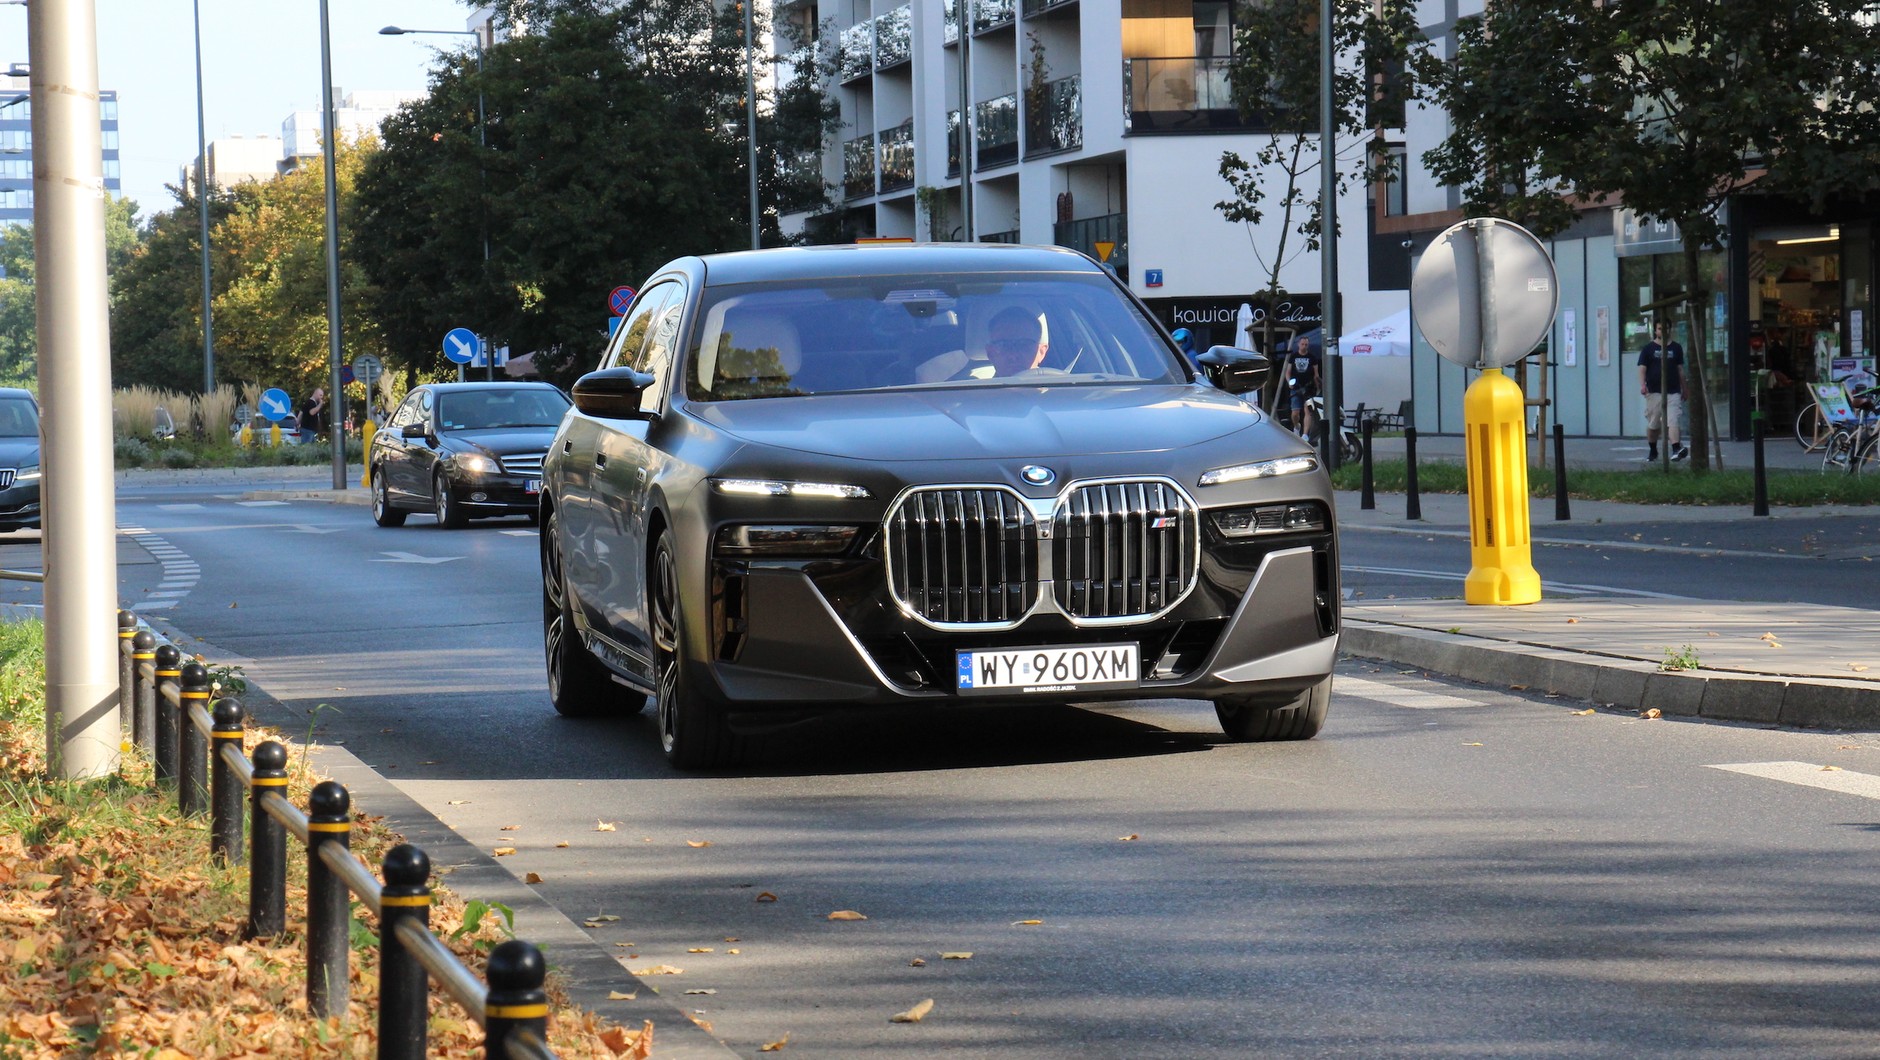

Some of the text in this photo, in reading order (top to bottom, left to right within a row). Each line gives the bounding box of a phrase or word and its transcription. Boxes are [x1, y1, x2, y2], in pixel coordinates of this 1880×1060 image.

[1151, 273, 1158, 283] 7
[1173, 305, 1266, 323] kawiara
[980, 649, 1130, 685] WY 960XM
[960, 674, 972, 684] PL
